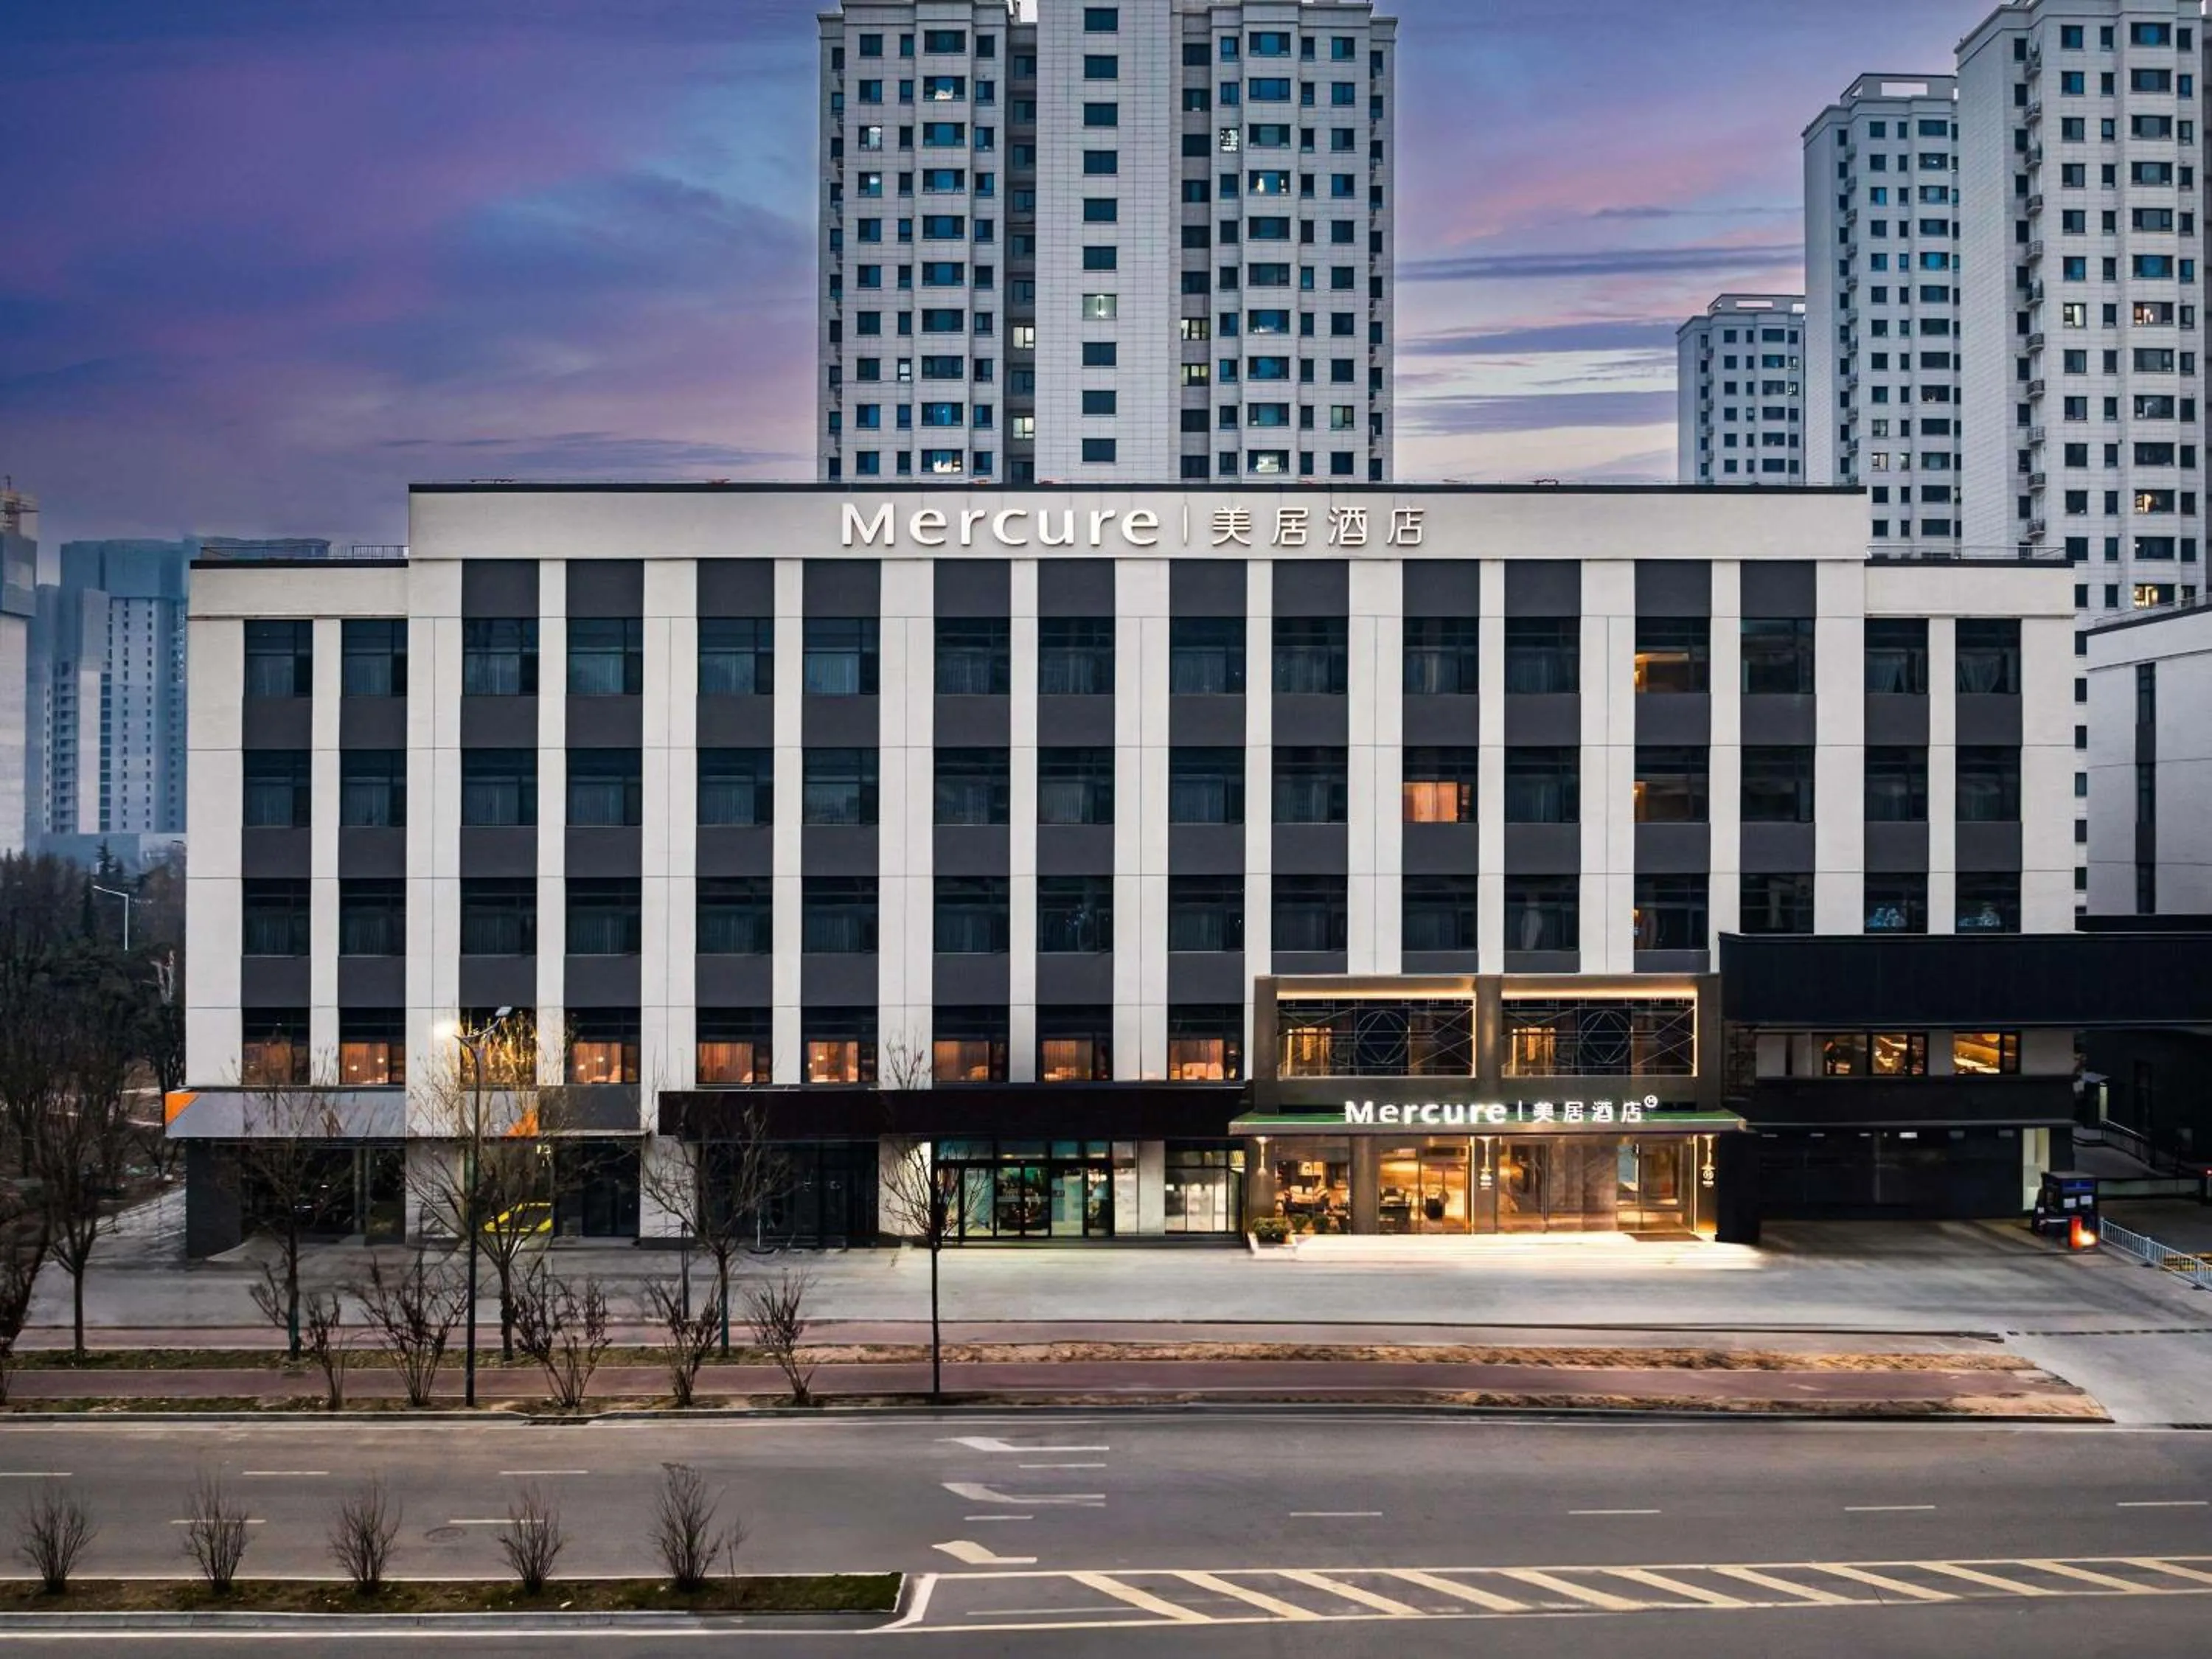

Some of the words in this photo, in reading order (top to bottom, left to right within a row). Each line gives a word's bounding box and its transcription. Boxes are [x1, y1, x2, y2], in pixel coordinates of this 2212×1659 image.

[841, 502, 1160, 546] Mercure
[1211, 506, 1426, 546] 美居酒店
[1344, 1100, 1507, 1124] Mercure
[1532, 1100, 1642, 1123] 美居酒店
